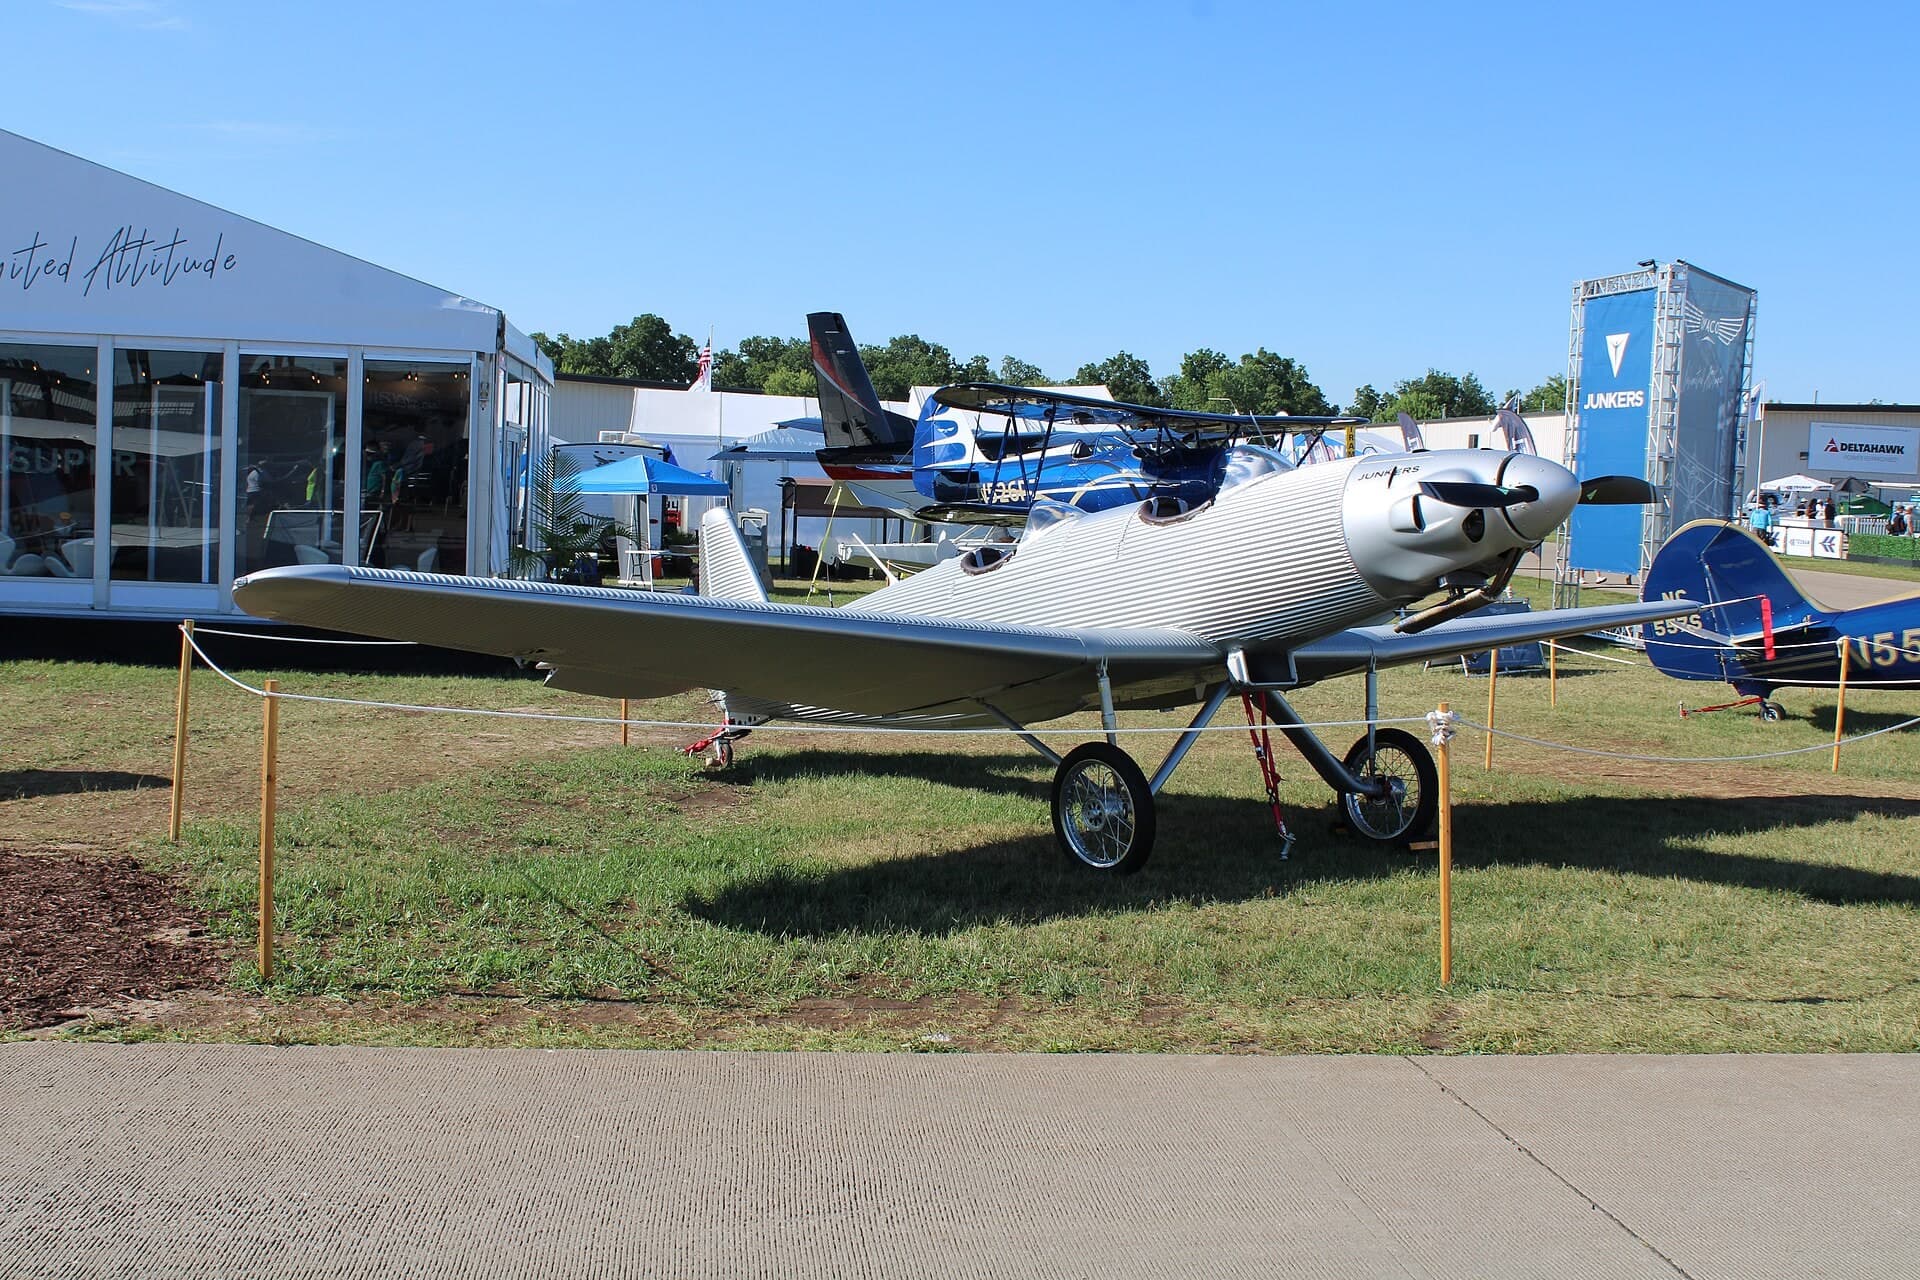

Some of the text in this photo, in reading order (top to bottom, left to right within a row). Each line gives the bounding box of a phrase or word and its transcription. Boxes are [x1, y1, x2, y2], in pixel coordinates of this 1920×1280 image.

[0, 224, 237, 297] ited Attitude
[1583, 390, 1645, 410] JUNKERS
[1840, 443, 1905, 455] DELTAHAWK
